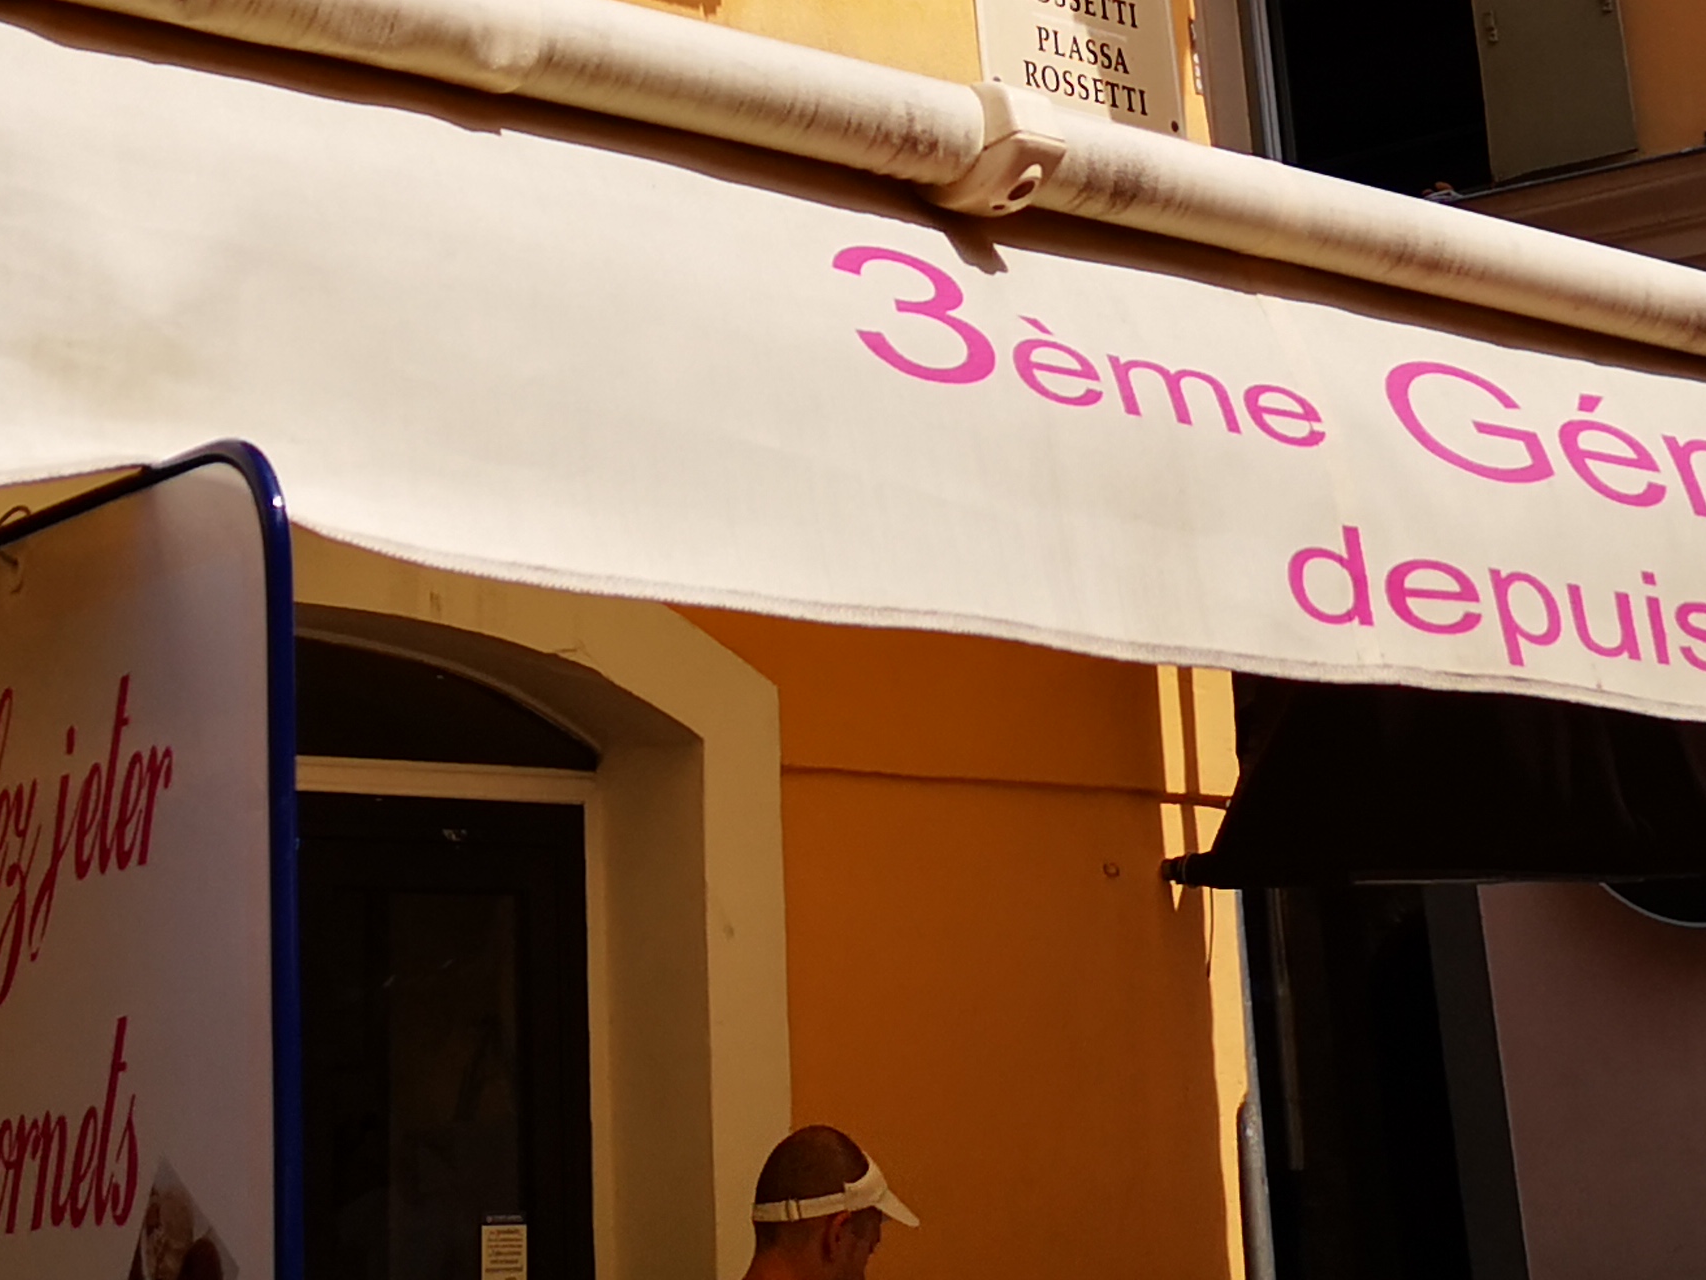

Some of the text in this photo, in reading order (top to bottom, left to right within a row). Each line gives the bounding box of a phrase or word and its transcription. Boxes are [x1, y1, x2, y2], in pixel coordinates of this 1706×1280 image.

[1023, 60, 1149, 117] ROSSETTI
[1036, 26, 1130, 75] PLASSA
[832, 245, 1326, 448] 3ème
[28, 672, 174, 963] jeter
